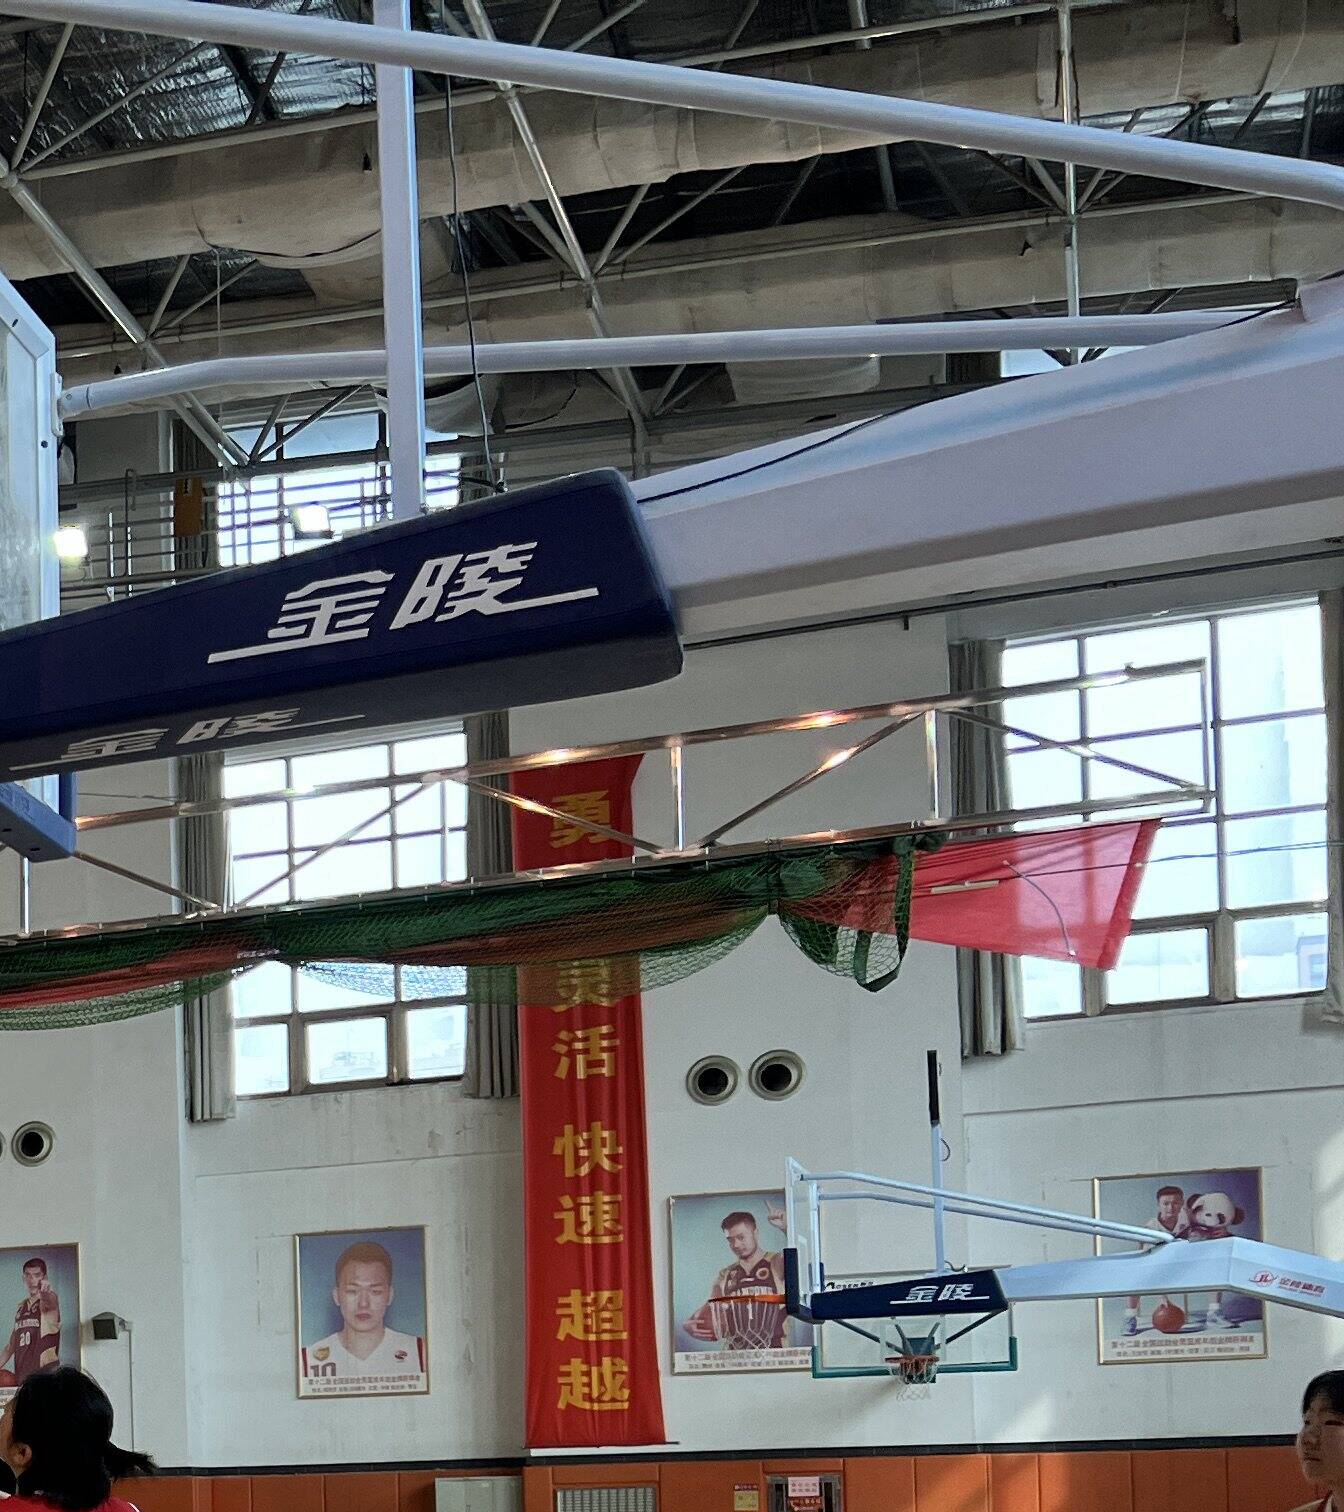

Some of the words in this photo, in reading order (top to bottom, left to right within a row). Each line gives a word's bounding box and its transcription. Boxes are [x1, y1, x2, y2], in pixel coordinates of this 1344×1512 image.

[207, 541, 599, 664] 金陵
[9, 707, 365, 772] 金陵
[552, 1123, 624, 1245] 快速
[556, 1288, 629, 1412] 超越
[890, 1284, 989, 1304] 金陵
